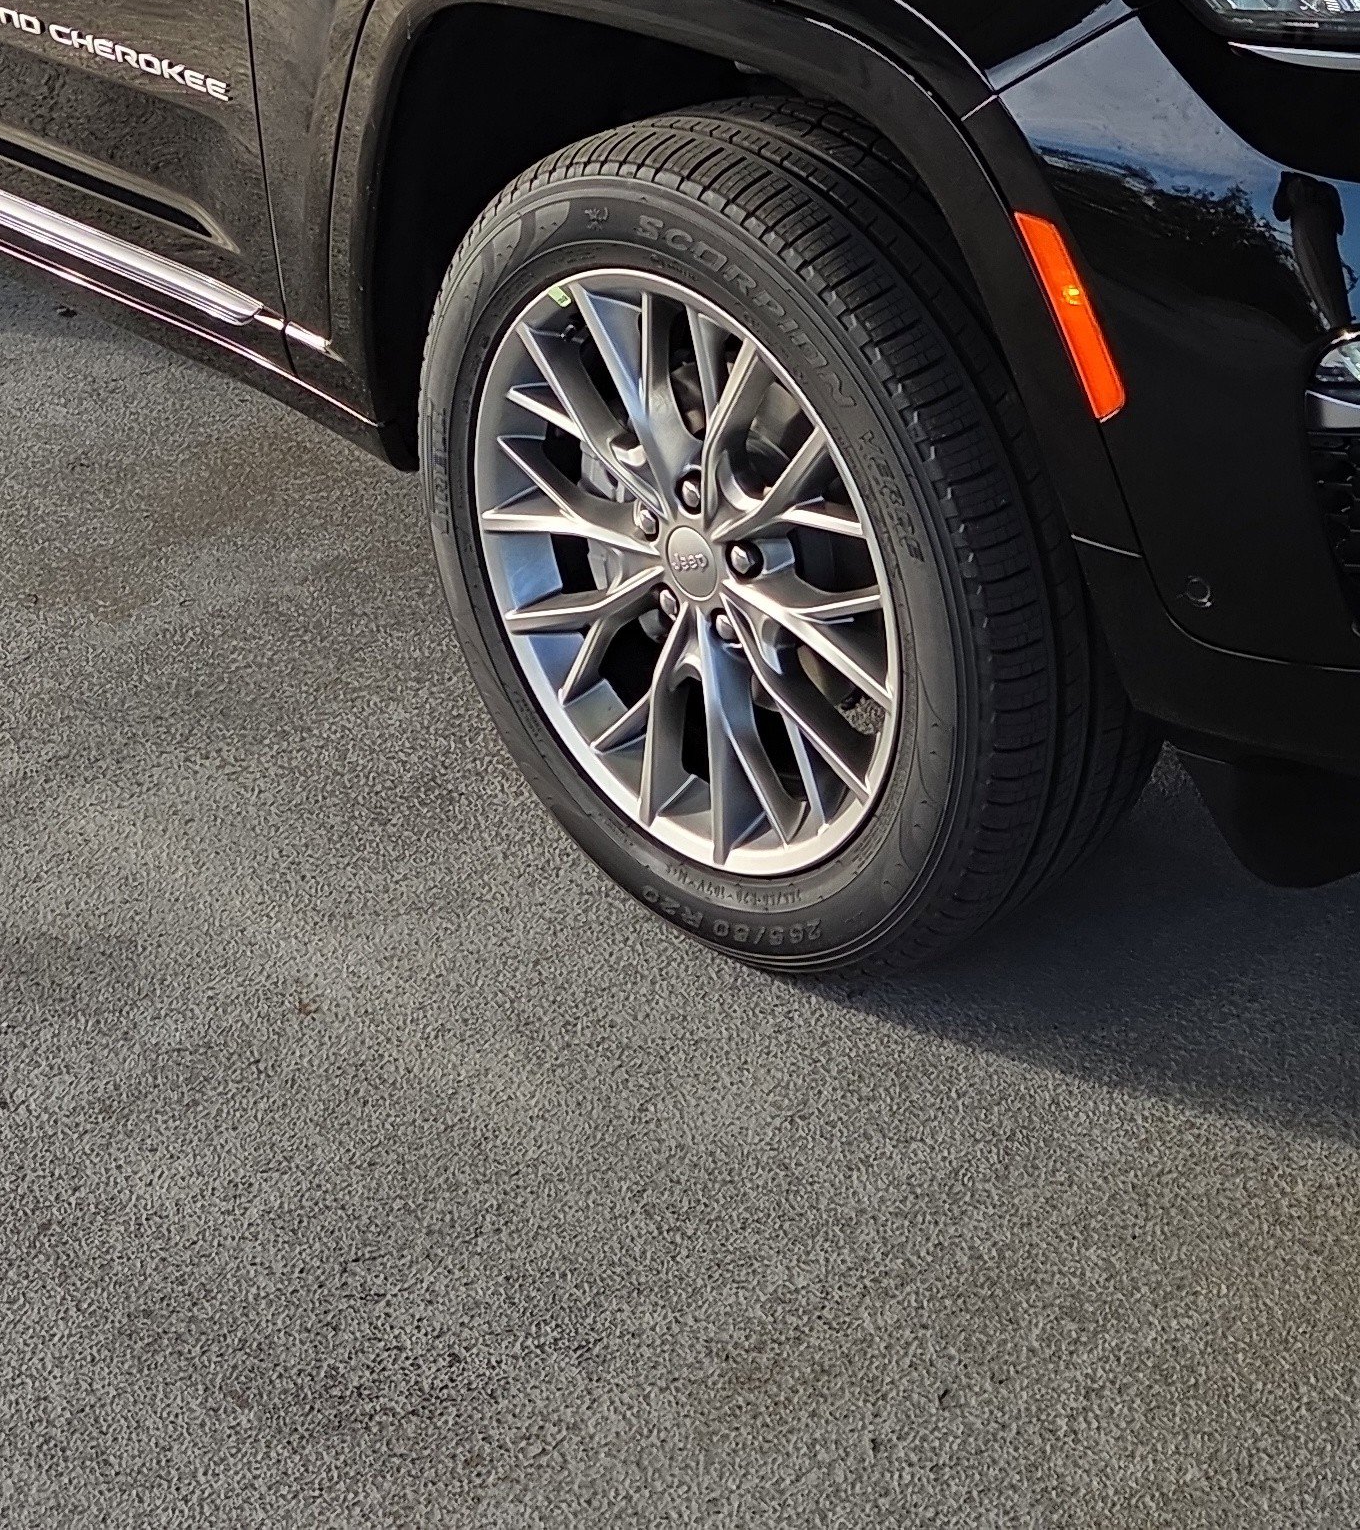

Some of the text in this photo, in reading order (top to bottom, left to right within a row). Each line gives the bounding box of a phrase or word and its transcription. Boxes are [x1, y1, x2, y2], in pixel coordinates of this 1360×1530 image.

[48, 23, 232, 102] CHEROKEE
[633, 215, 857, 408] SCORPION
[671, 552, 708, 572] Jeep
